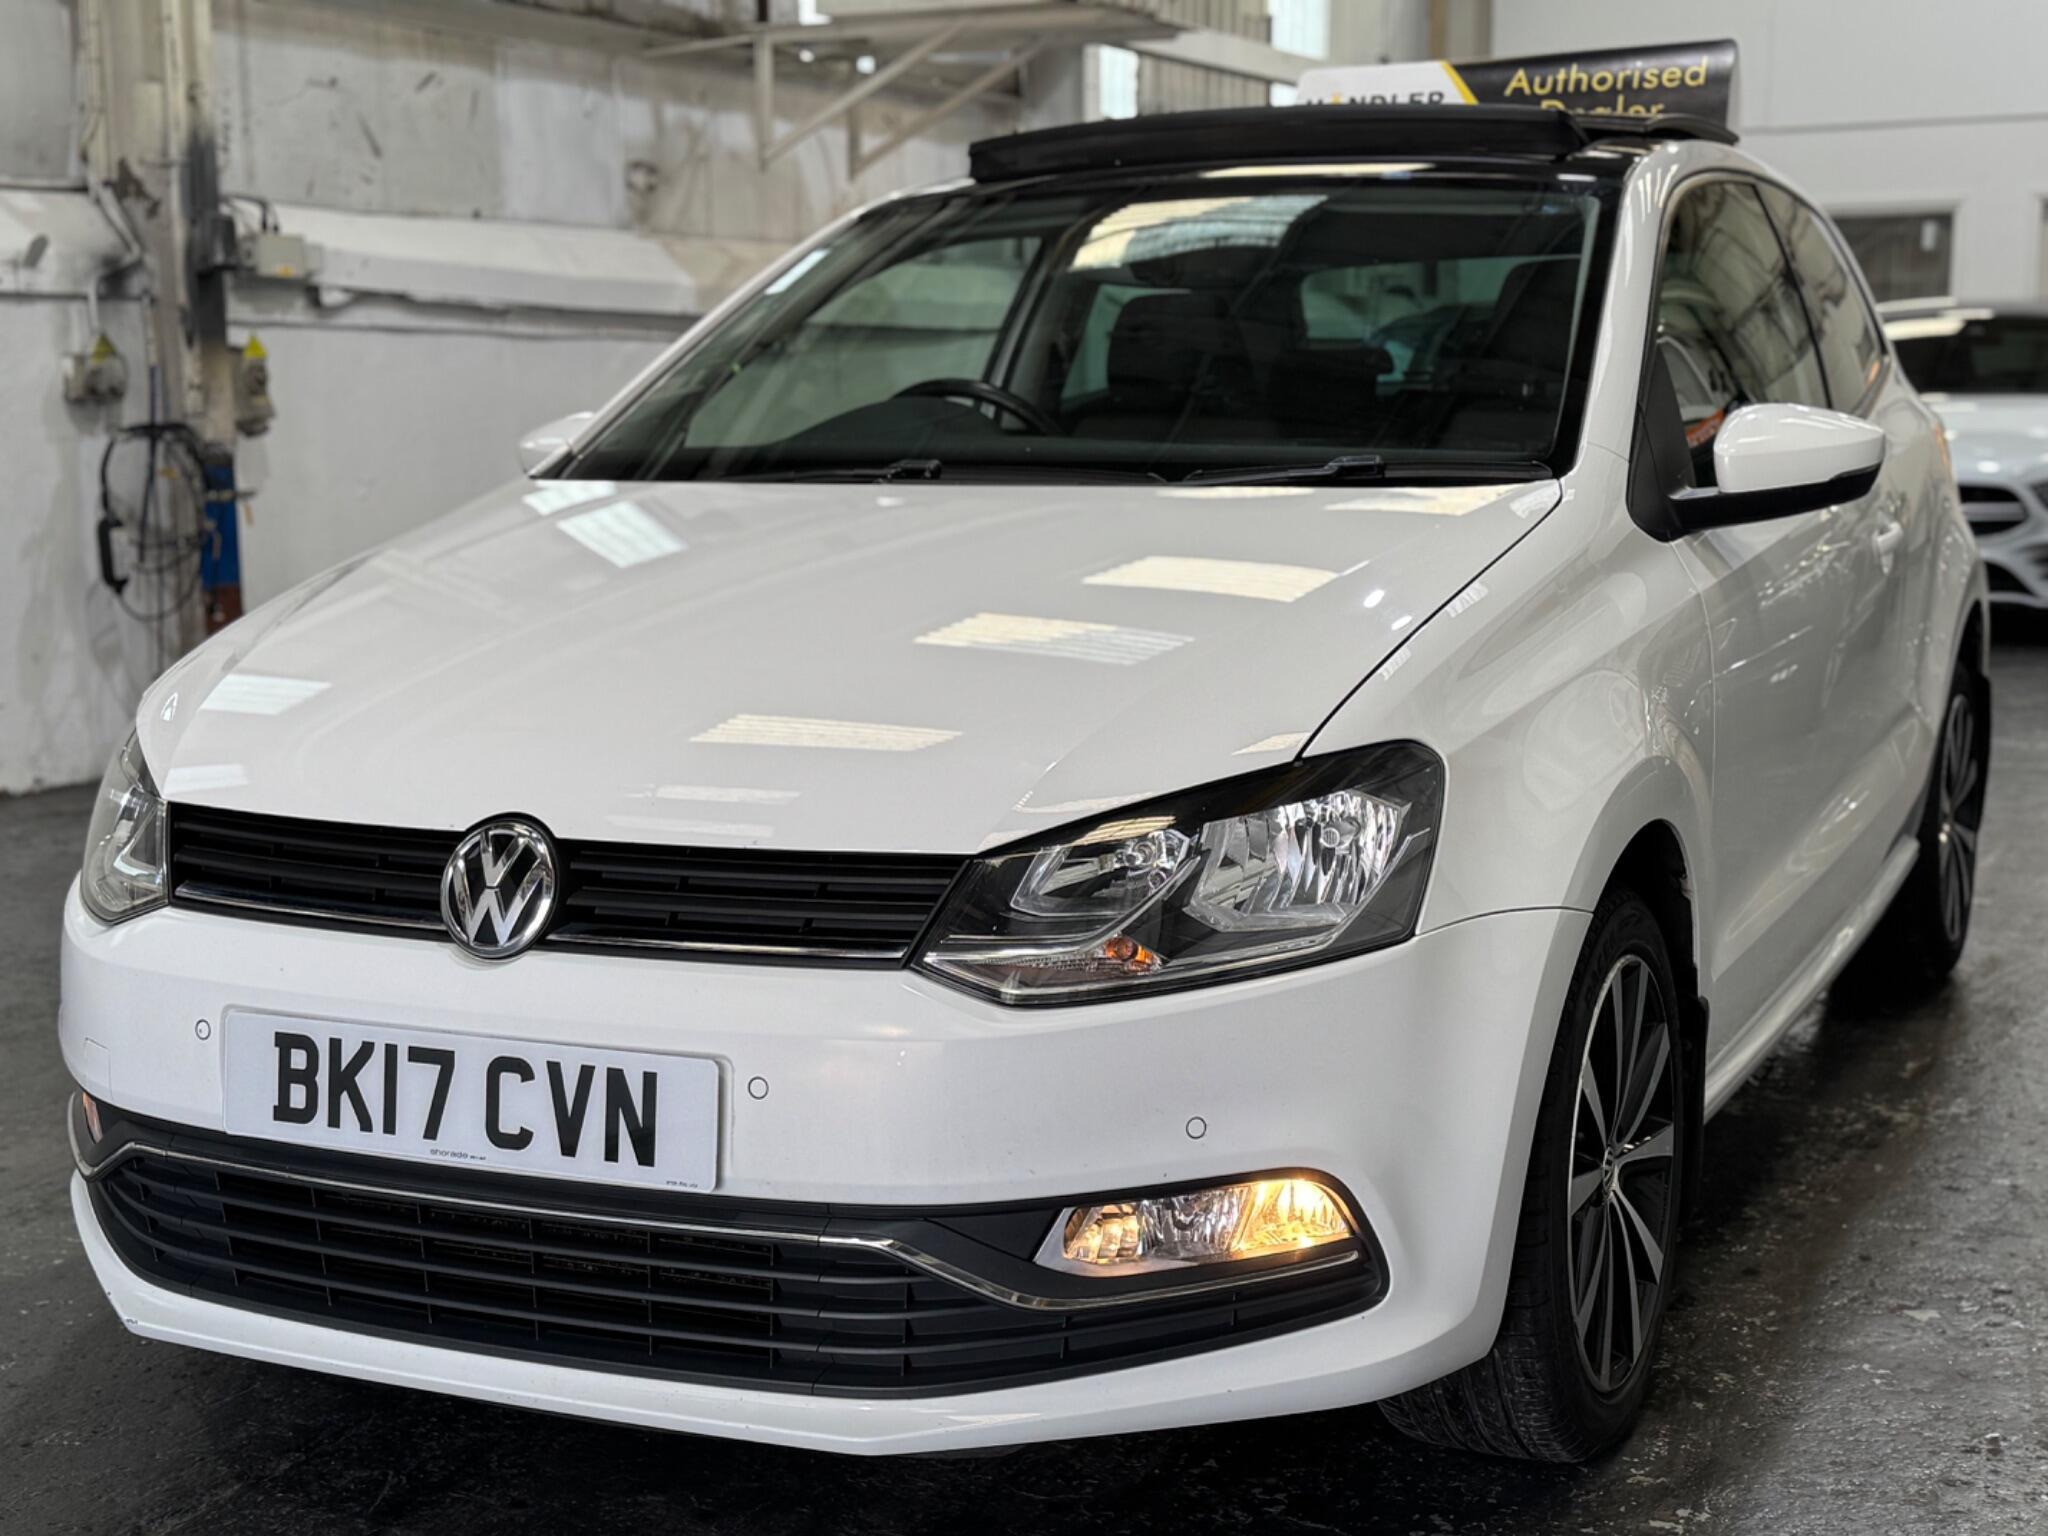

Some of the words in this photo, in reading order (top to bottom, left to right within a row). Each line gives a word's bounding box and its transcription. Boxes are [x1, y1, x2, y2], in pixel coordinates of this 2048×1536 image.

[1503, 56, 1709, 97] Authorised
[273, 1031, 456, 1141] BK17
[485, 1055, 658, 1168] CVN
